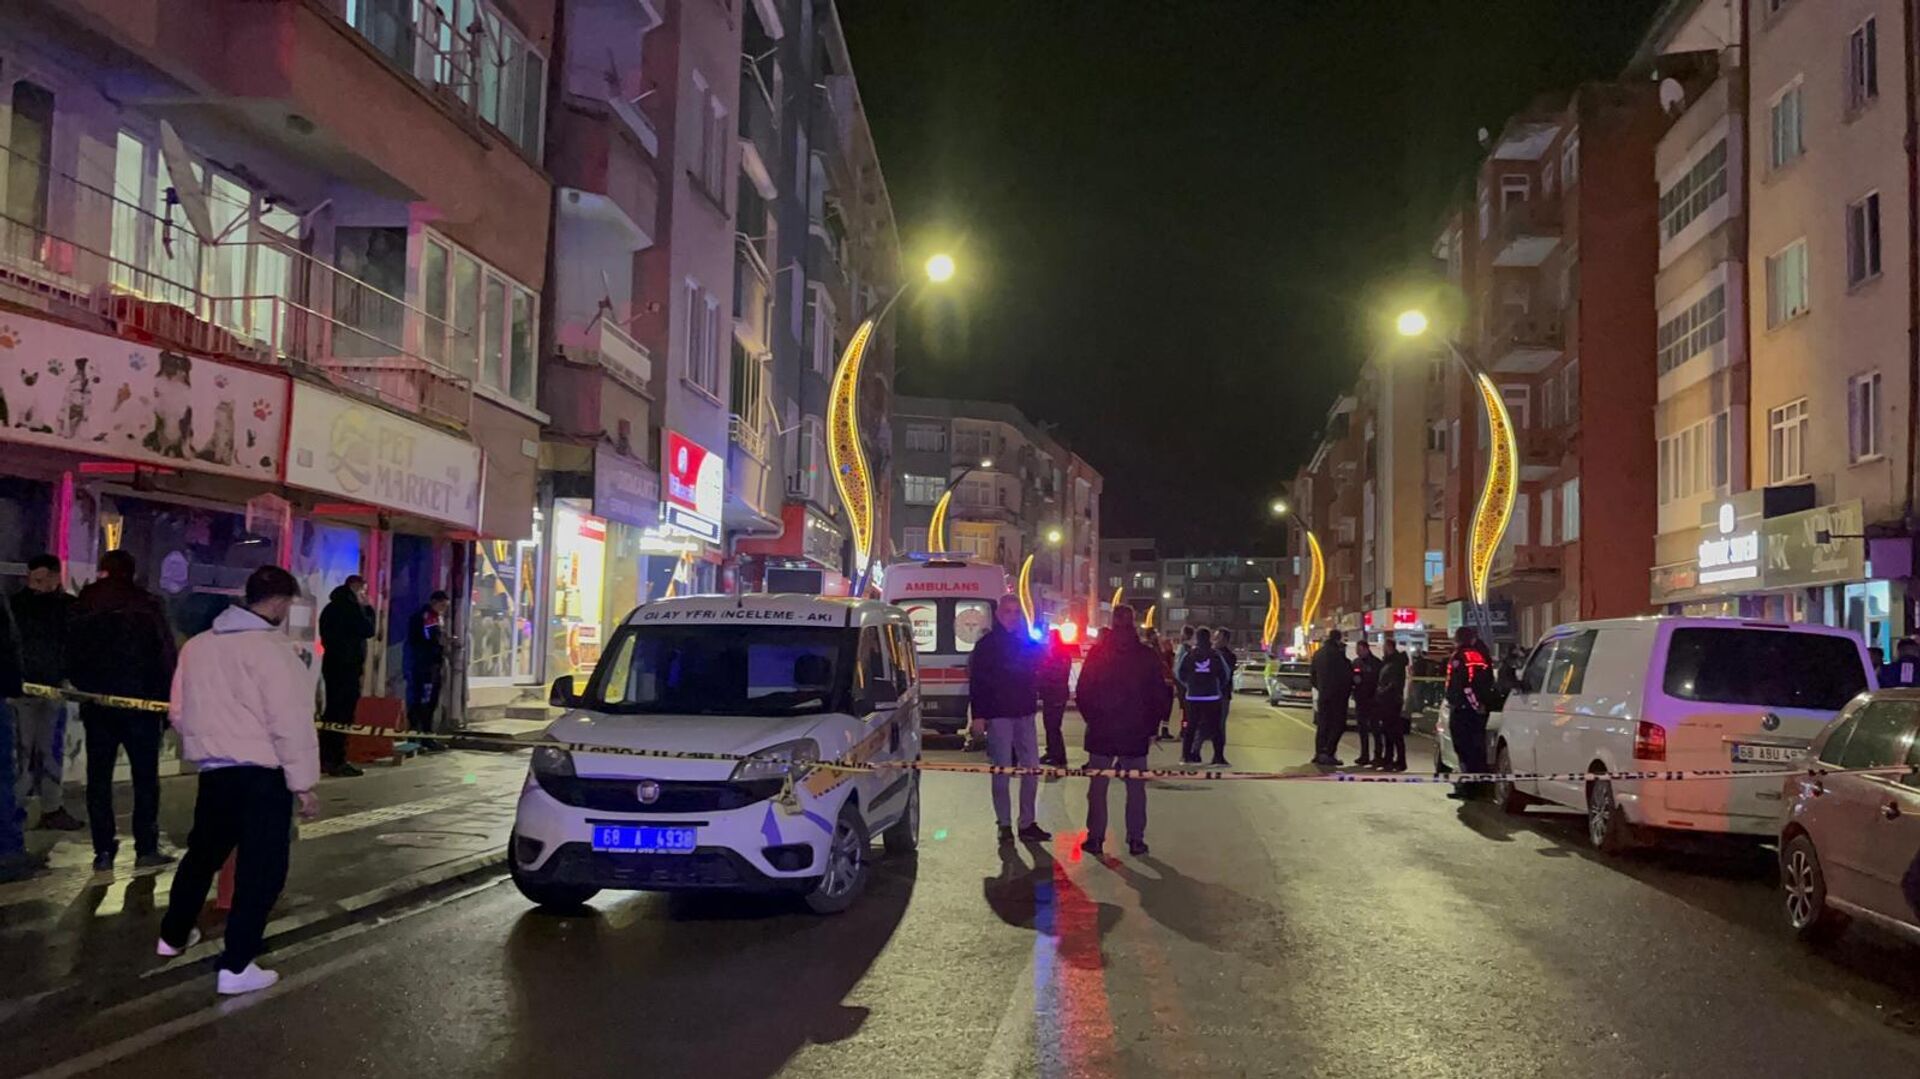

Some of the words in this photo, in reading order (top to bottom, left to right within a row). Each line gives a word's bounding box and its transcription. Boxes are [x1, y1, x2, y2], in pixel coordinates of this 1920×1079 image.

[377, 427, 416, 470] PET
[374, 464, 453, 514] MARKET
[905, 582, 979, 592] AMBULANS
[603, 828, 620, 846] 68
[634, 830, 642, 846] A
